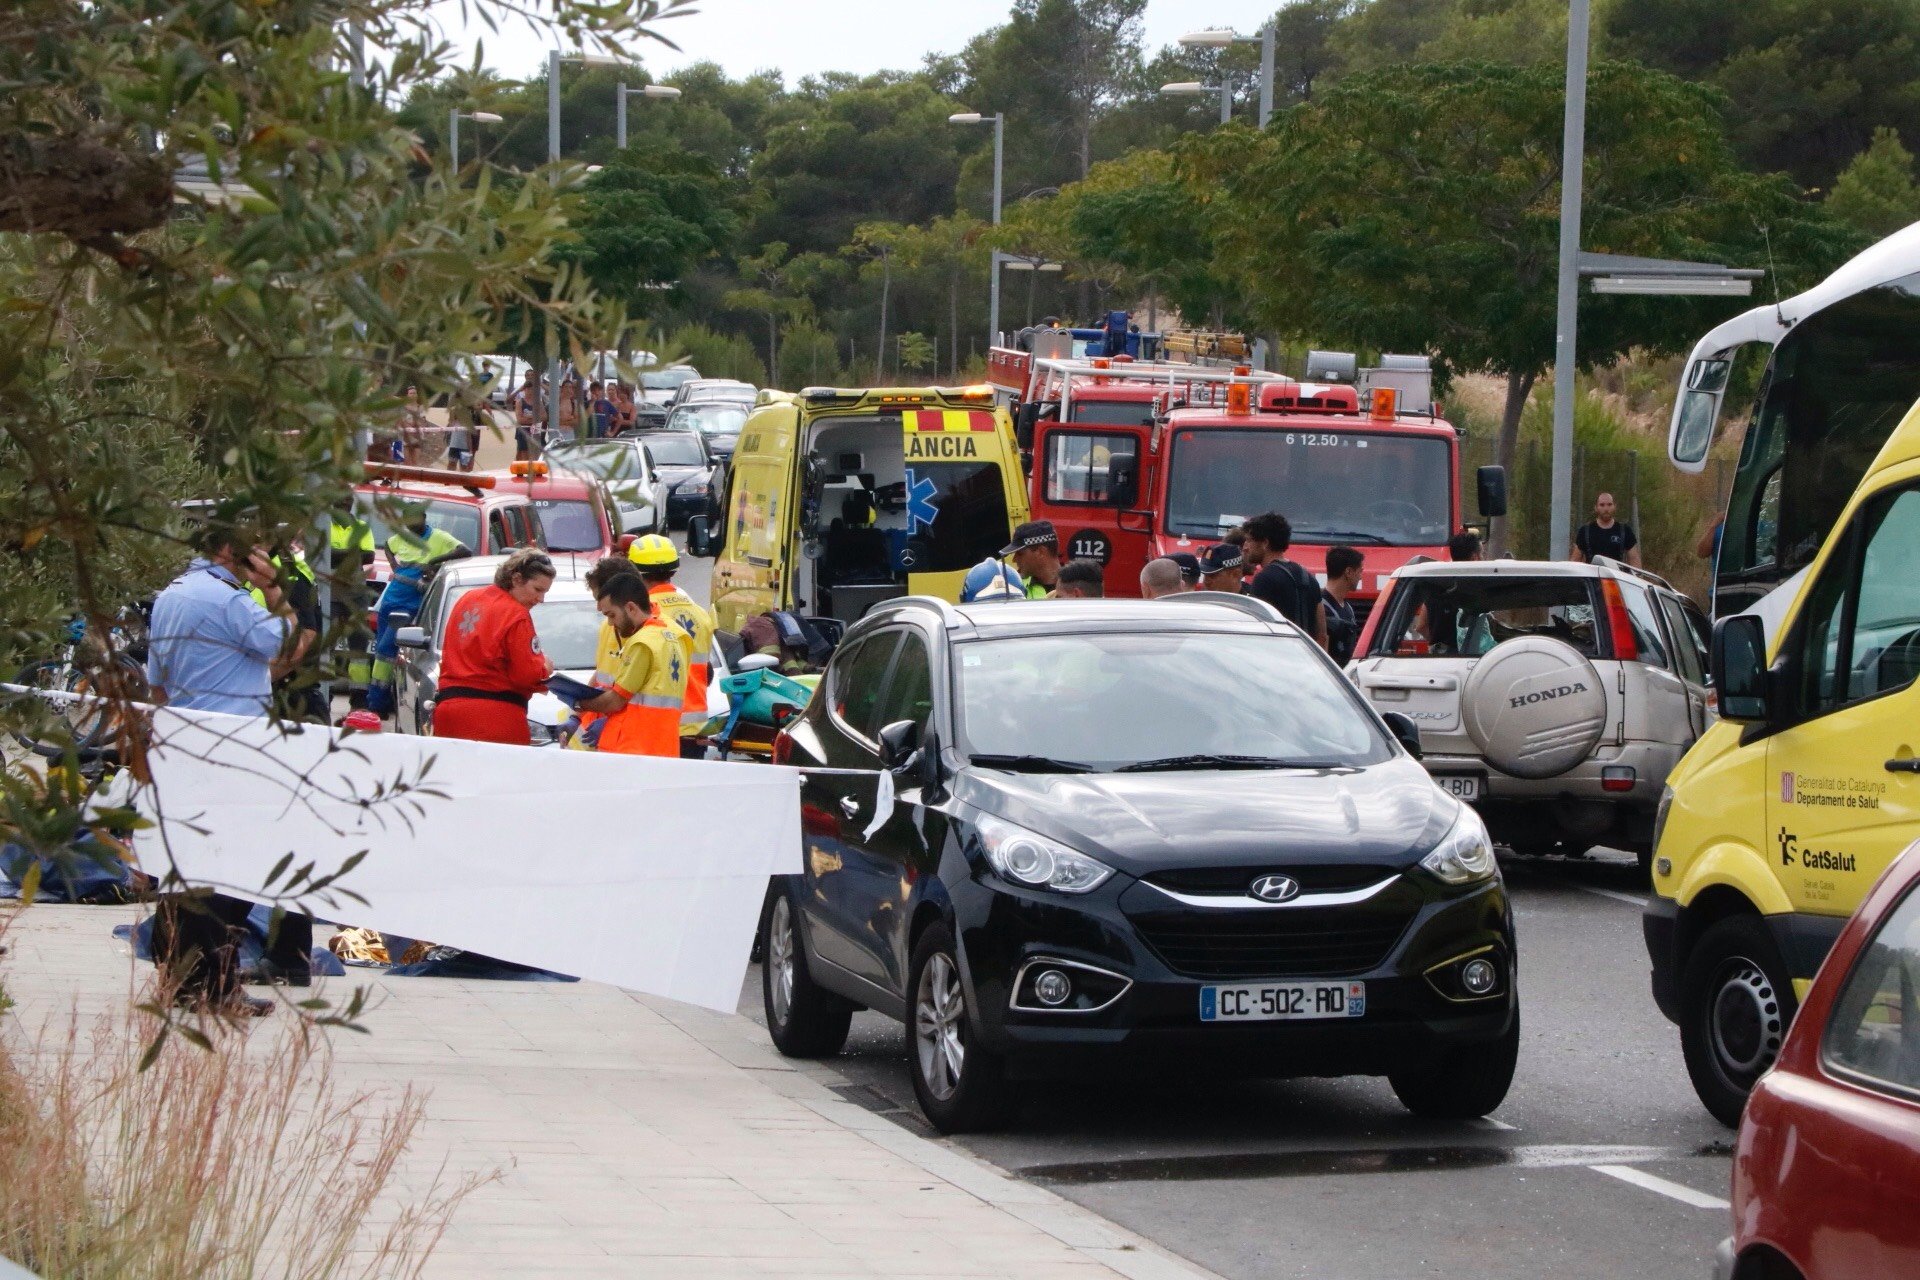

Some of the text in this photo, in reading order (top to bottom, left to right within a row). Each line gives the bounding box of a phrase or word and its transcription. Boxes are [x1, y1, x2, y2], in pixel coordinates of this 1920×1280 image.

[904, 432, 977, 457] ÀNCIA
[1285, 433, 1339, 446] 6 12.50
[1075, 540, 1105, 556] 112
[1508, 682, 1588, 709] HONDA
[1796, 774, 1886, 796] Generalitat de Catalunya
[1796, 791, 1879, 809] Departament de Salut
[1802, 848, 1856, 872] CatSalut
